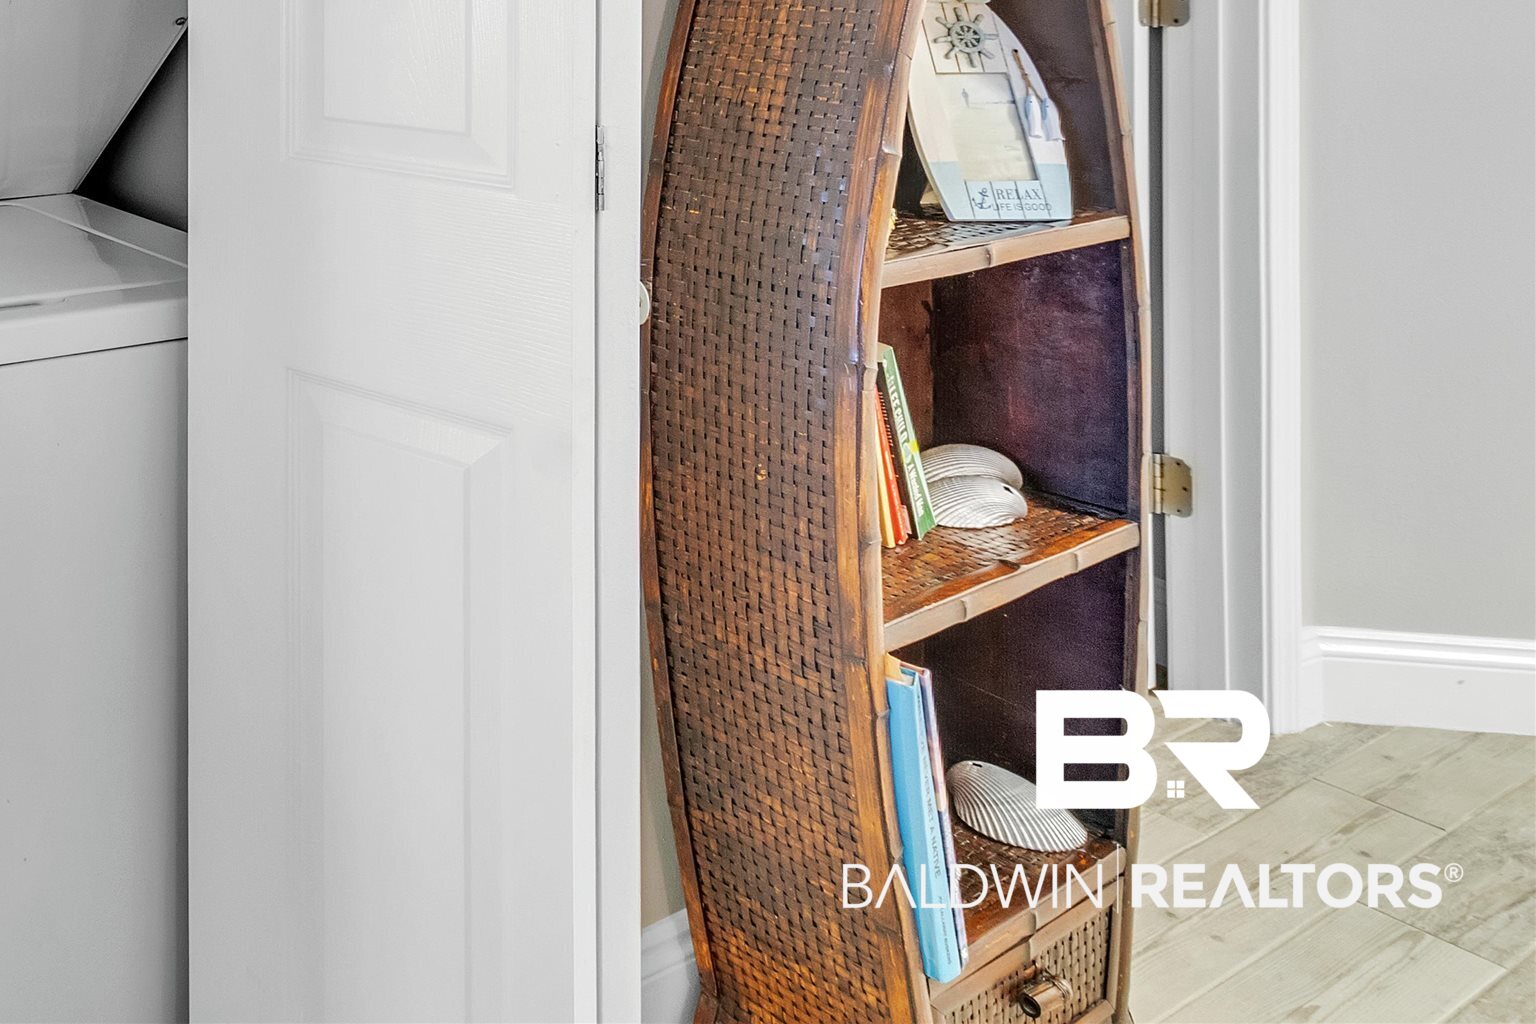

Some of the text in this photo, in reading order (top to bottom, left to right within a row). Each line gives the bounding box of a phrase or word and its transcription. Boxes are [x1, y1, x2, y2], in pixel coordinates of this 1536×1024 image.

[996, 188, 1042, 200] RELAX
[887, 386, 901, 407] LEE
[892, 408, 909, 442] CHILD
[930, 837, 941, 879] NATIVE
